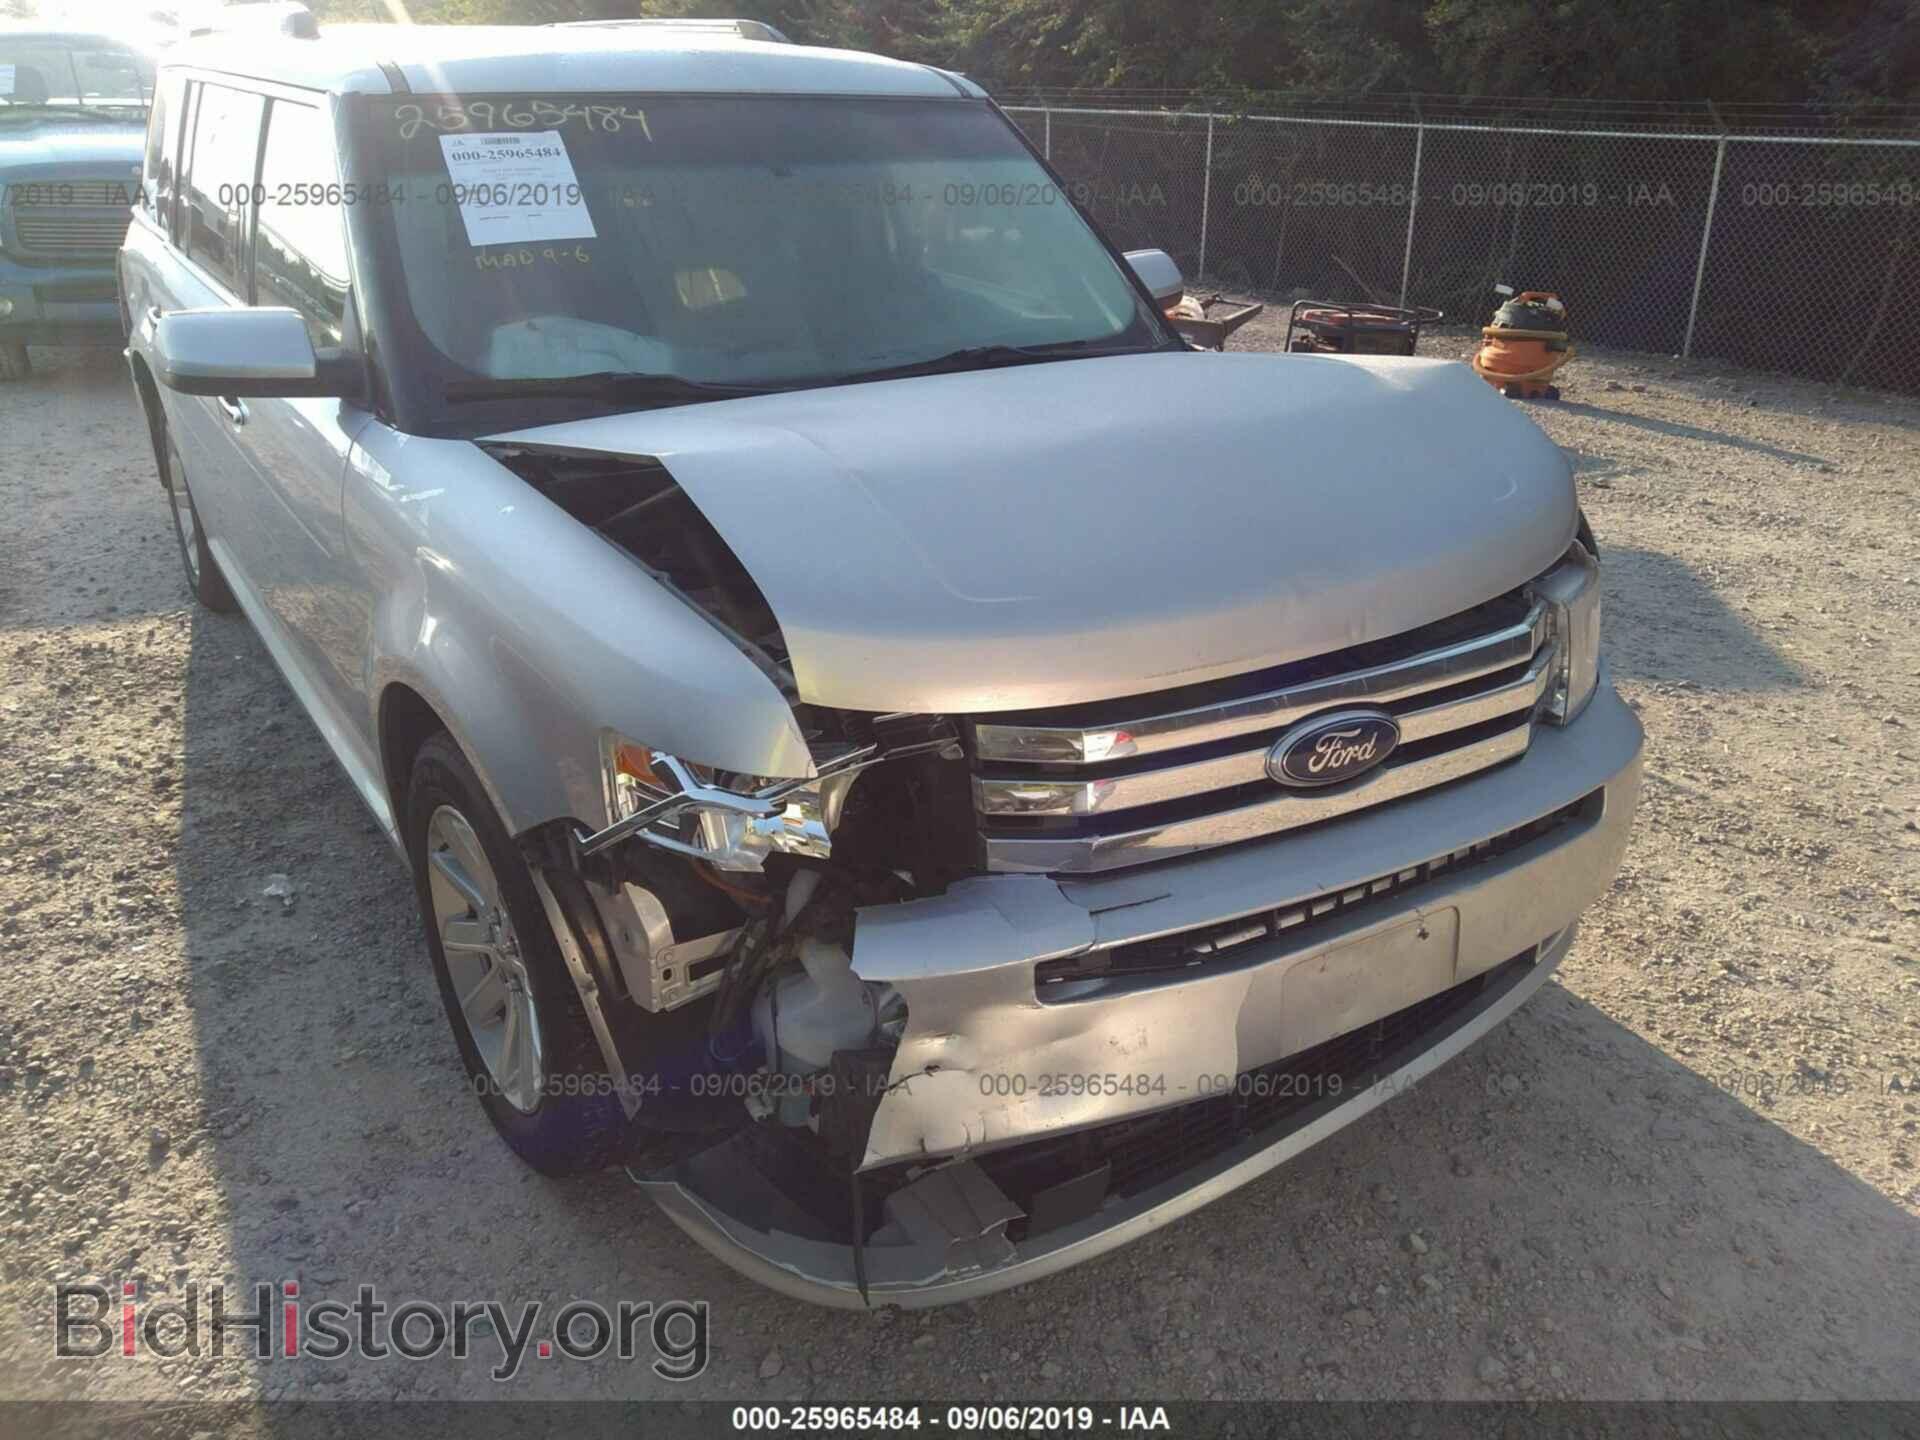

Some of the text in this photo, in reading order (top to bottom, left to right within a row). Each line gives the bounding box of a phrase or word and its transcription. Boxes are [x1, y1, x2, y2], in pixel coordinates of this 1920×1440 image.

[395, 101, 653, 142] 25965484
[451, 147, 562, 162] 000-25965484
[1308, 728, 1377, 773] Ford
